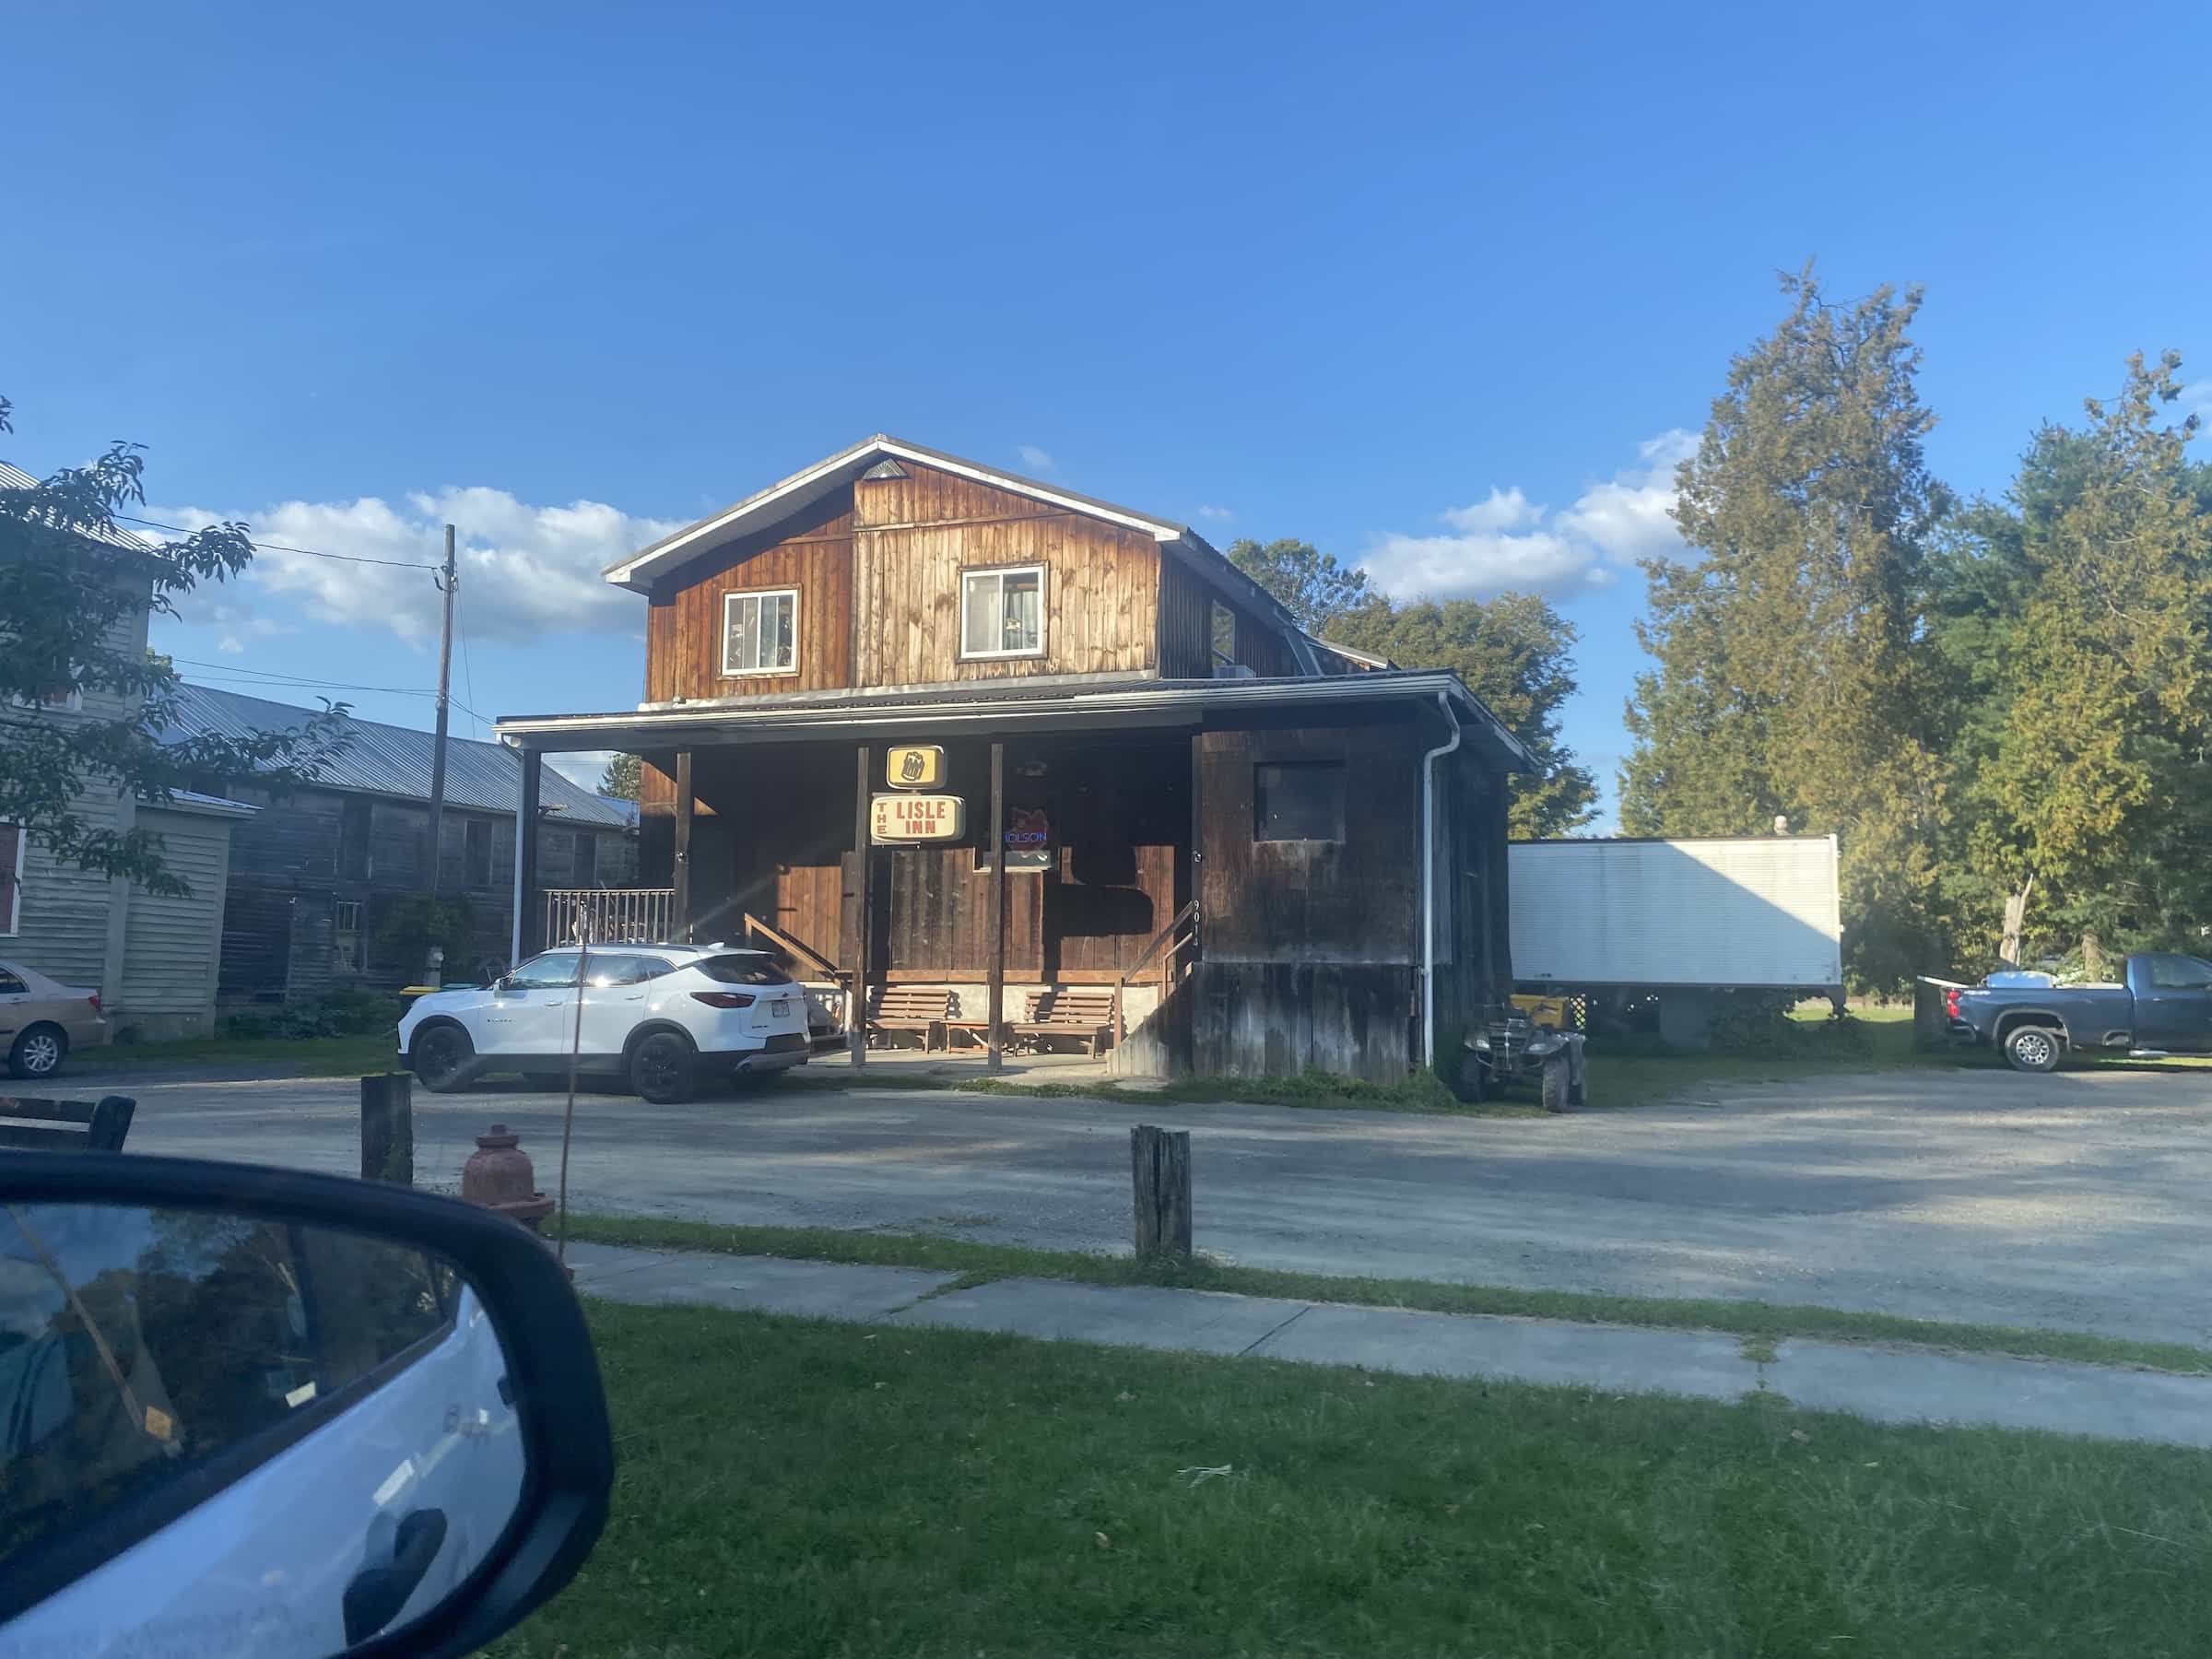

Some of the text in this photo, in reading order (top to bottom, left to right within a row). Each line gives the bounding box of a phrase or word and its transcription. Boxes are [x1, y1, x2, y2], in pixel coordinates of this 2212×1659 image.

[877, 803, 887, 834] THE
[897, 802, 947, 819] LISLE
[906, 820, 936, 834] INN
